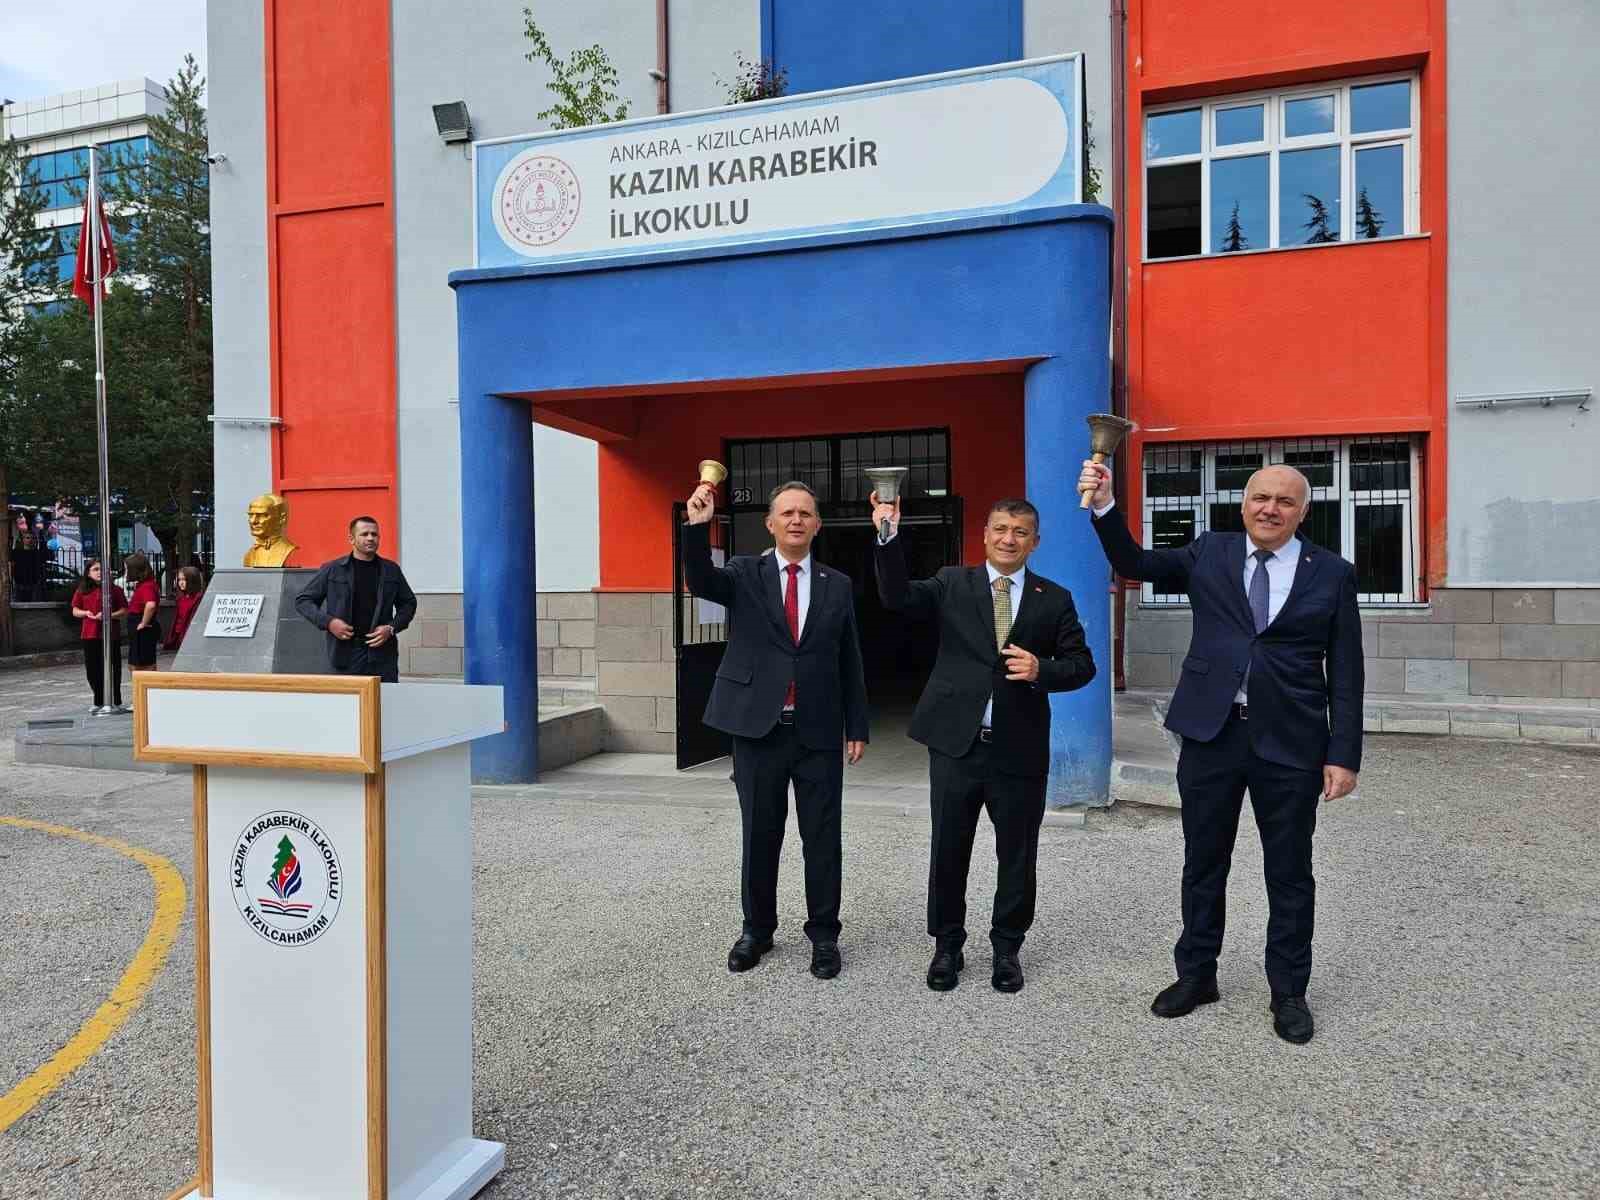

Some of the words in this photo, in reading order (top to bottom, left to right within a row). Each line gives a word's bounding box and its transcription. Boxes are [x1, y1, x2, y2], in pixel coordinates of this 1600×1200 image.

[610, 138, 681, 163] ANKARA
[697, 115, 840, 152] KIZILCAHAMAM
[610, 164, 699, 199] KAZIM
[708, 137, 878, 187] KARABEKİR
[610, 198, 749, 239] İLKOKULU
[234, 843, 248, 888] KAZIM
[244, 815, 310, 844] KARABEKİR
[310, 827, 339, 900] İLKOKULU
[243, 905, 329, 943] KIZILCAHAMAM
